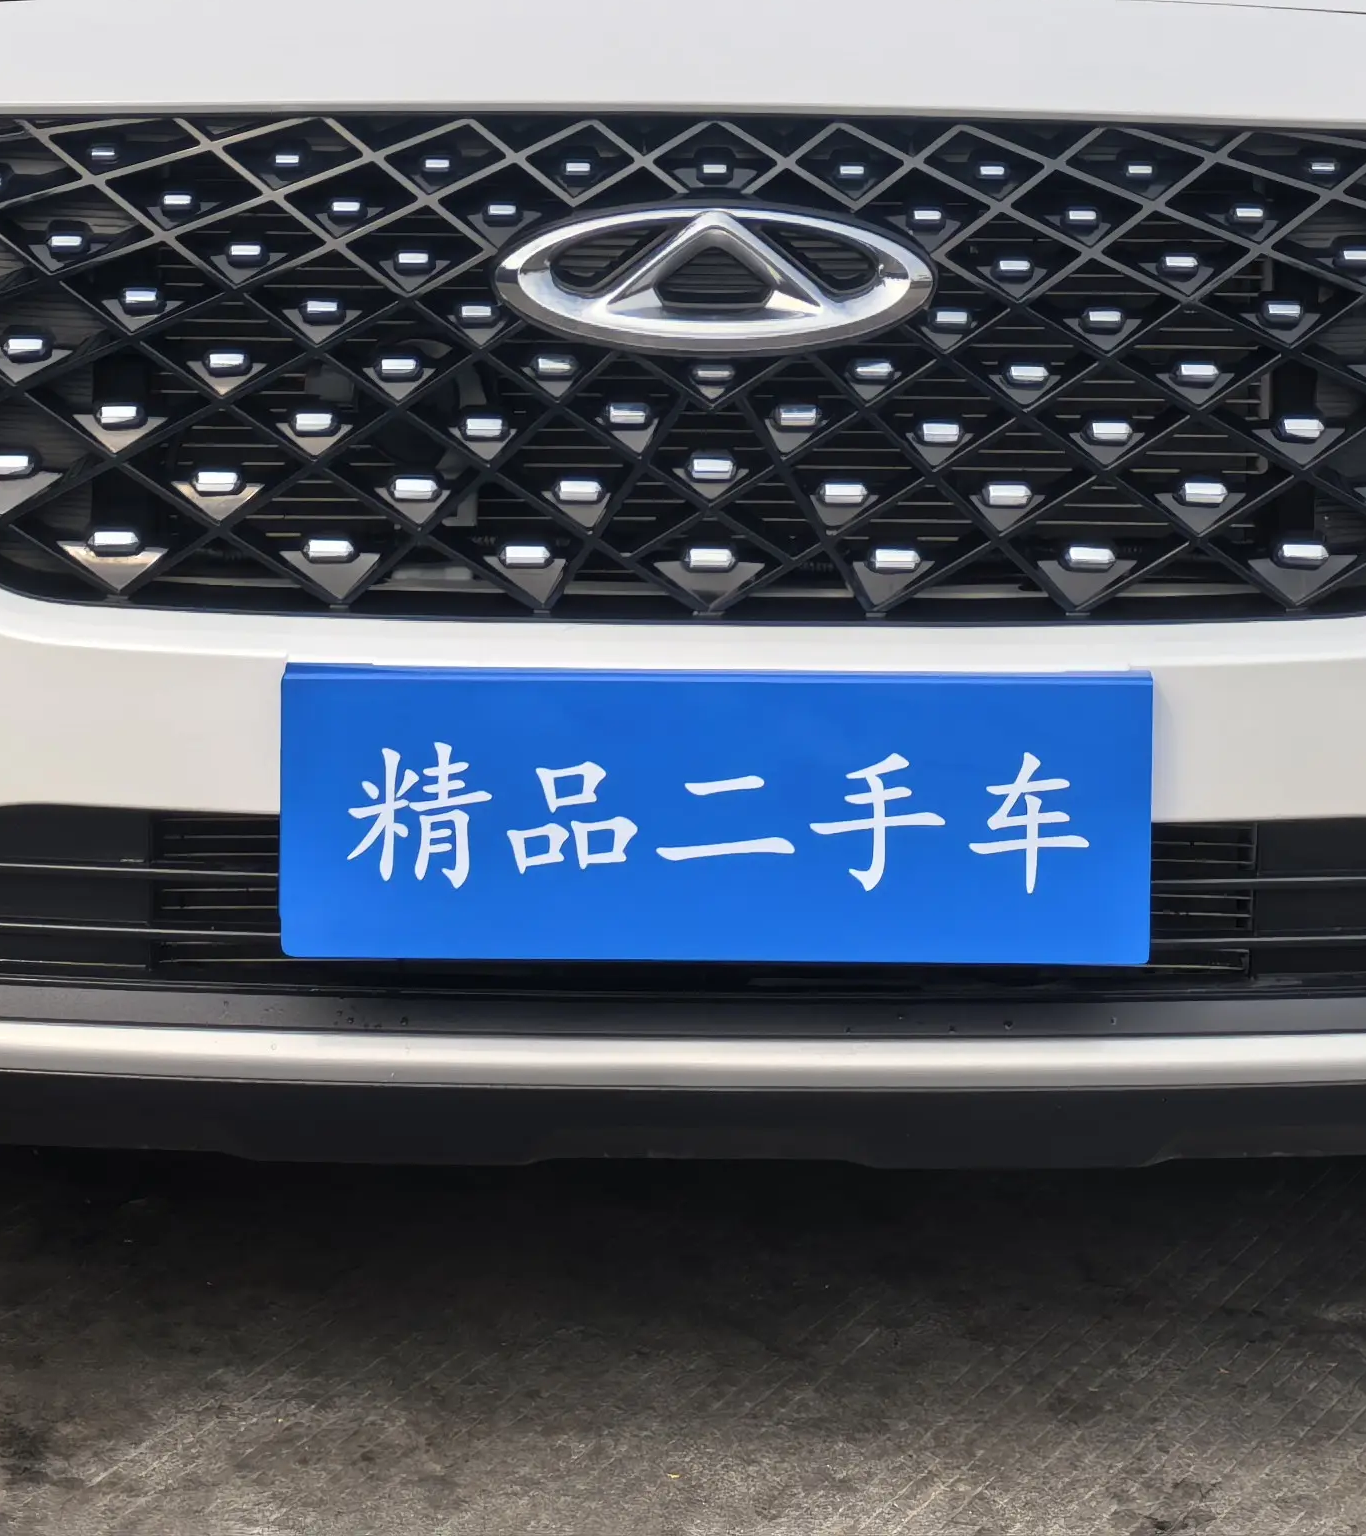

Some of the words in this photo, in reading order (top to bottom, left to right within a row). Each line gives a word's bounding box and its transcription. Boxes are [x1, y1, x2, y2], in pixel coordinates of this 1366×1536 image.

[347, 741, 1090, 894] 精品二手车
